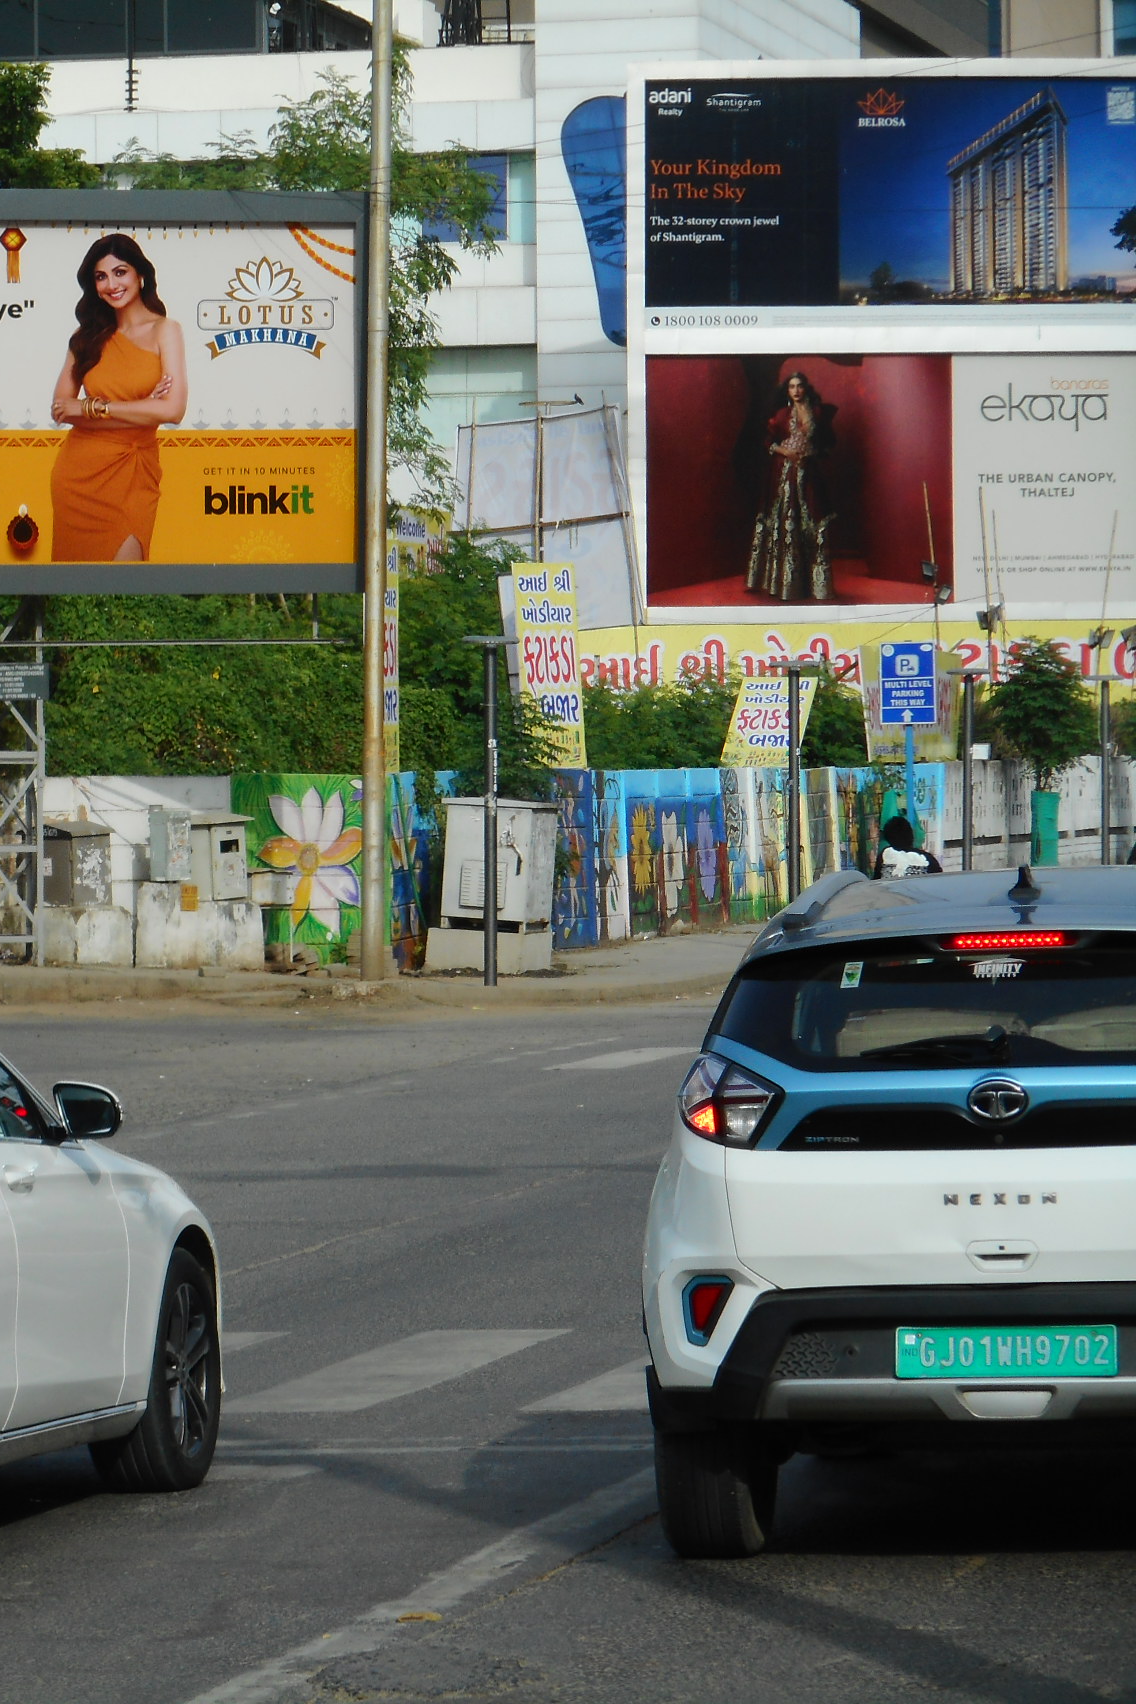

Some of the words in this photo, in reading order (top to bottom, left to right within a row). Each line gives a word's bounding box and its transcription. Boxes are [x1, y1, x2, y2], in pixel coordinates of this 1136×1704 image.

[649, 88, 692, 103] adani
[706, 98, 762, 108] Shantigram
[658, 107, 683, 117] Realty
[858, 117, 906, 127] BELROSA
[650, 159, 692, 175] Your
[696, 158, 781, 179] Kingdom
[650, 183, 669, 199] In
[673, 182, 709, 199] The
[713, 182, 746, 202] Sky
[650, 216, 670, 226] The
[672, 216, 718, 228] 32-storey
[720, 218, 751, 226] crown
[752, 215, 779, 228] jewel
[650, 232, 662, 242] of
[663, 231, 725, 244] Shantigram.
[218, 305, 314, 325] LOTUS
[664, 315, 695, 327] 1800
[699, 315, 721, 326] 108
[724, 315, 759, 326] 0009
[223, 328, 308, 348] MAKHANA
[980, 382, 1109, 431] ekaya
[203, 467, 223, 475] GET
[226, 467, 238, 475] IT
[240, 467, 251, 475] IN
[254, 467, 266, 475] 10
[269, 466, 316, 475] MINUTES
[978, 473, 1004, 483] THE
[1008, 473, 1054, 483] URBAN
[1058, 472, 1117, 483] CANOPY,
[1020, 487, 1076, 498] THALTEJ
[204, 485, 315, 515] blinkit
[554, 569, 571, 592] શ્રી
[521, 598, 572, 623] ખોડીયાર
[900, 658, 910, 672] P
[909, 680, 932, 688] LEVEL
[972, 963, 1023, 975] INFINITY
[805, 1135, 860, 1144] ZIPTRON
[943, 1191, 1057, 1206] NEXON
[901, 1348, 918, 1357] IND
[920, 1334, 1110, 1368] GJ01WH9702
